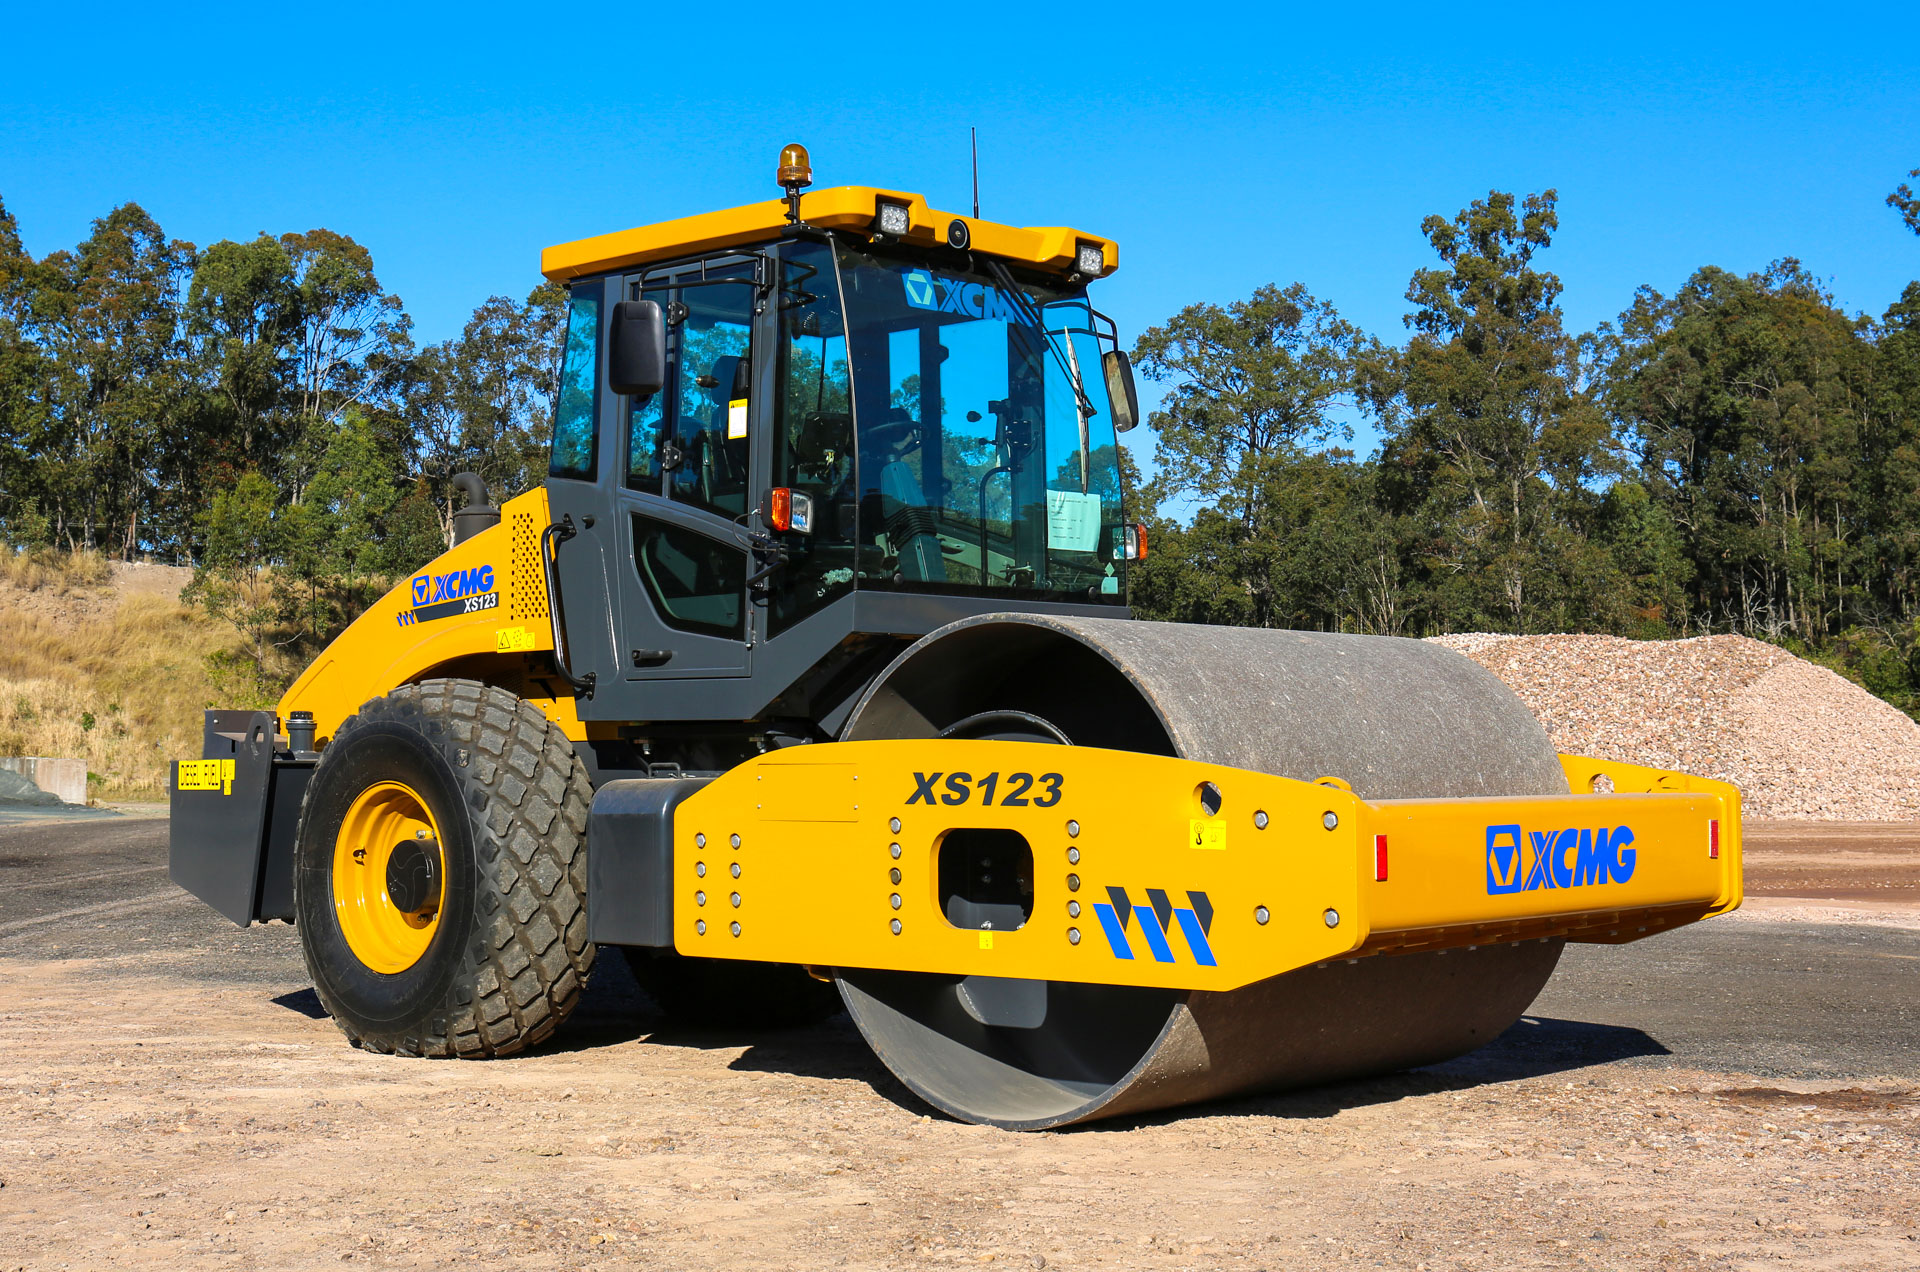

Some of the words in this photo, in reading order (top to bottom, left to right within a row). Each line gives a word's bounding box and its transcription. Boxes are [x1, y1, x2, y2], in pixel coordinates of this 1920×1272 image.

[430, 564, 495, 603] XCMG
[463, 592, 497, 614] XS123
[180, 764, 200, 786] DIESEL
[204, 763, 219, 786] FUEL
[904, 771, 1064, 808] XS123
[1521, 825, 1637, 891] XCMG
